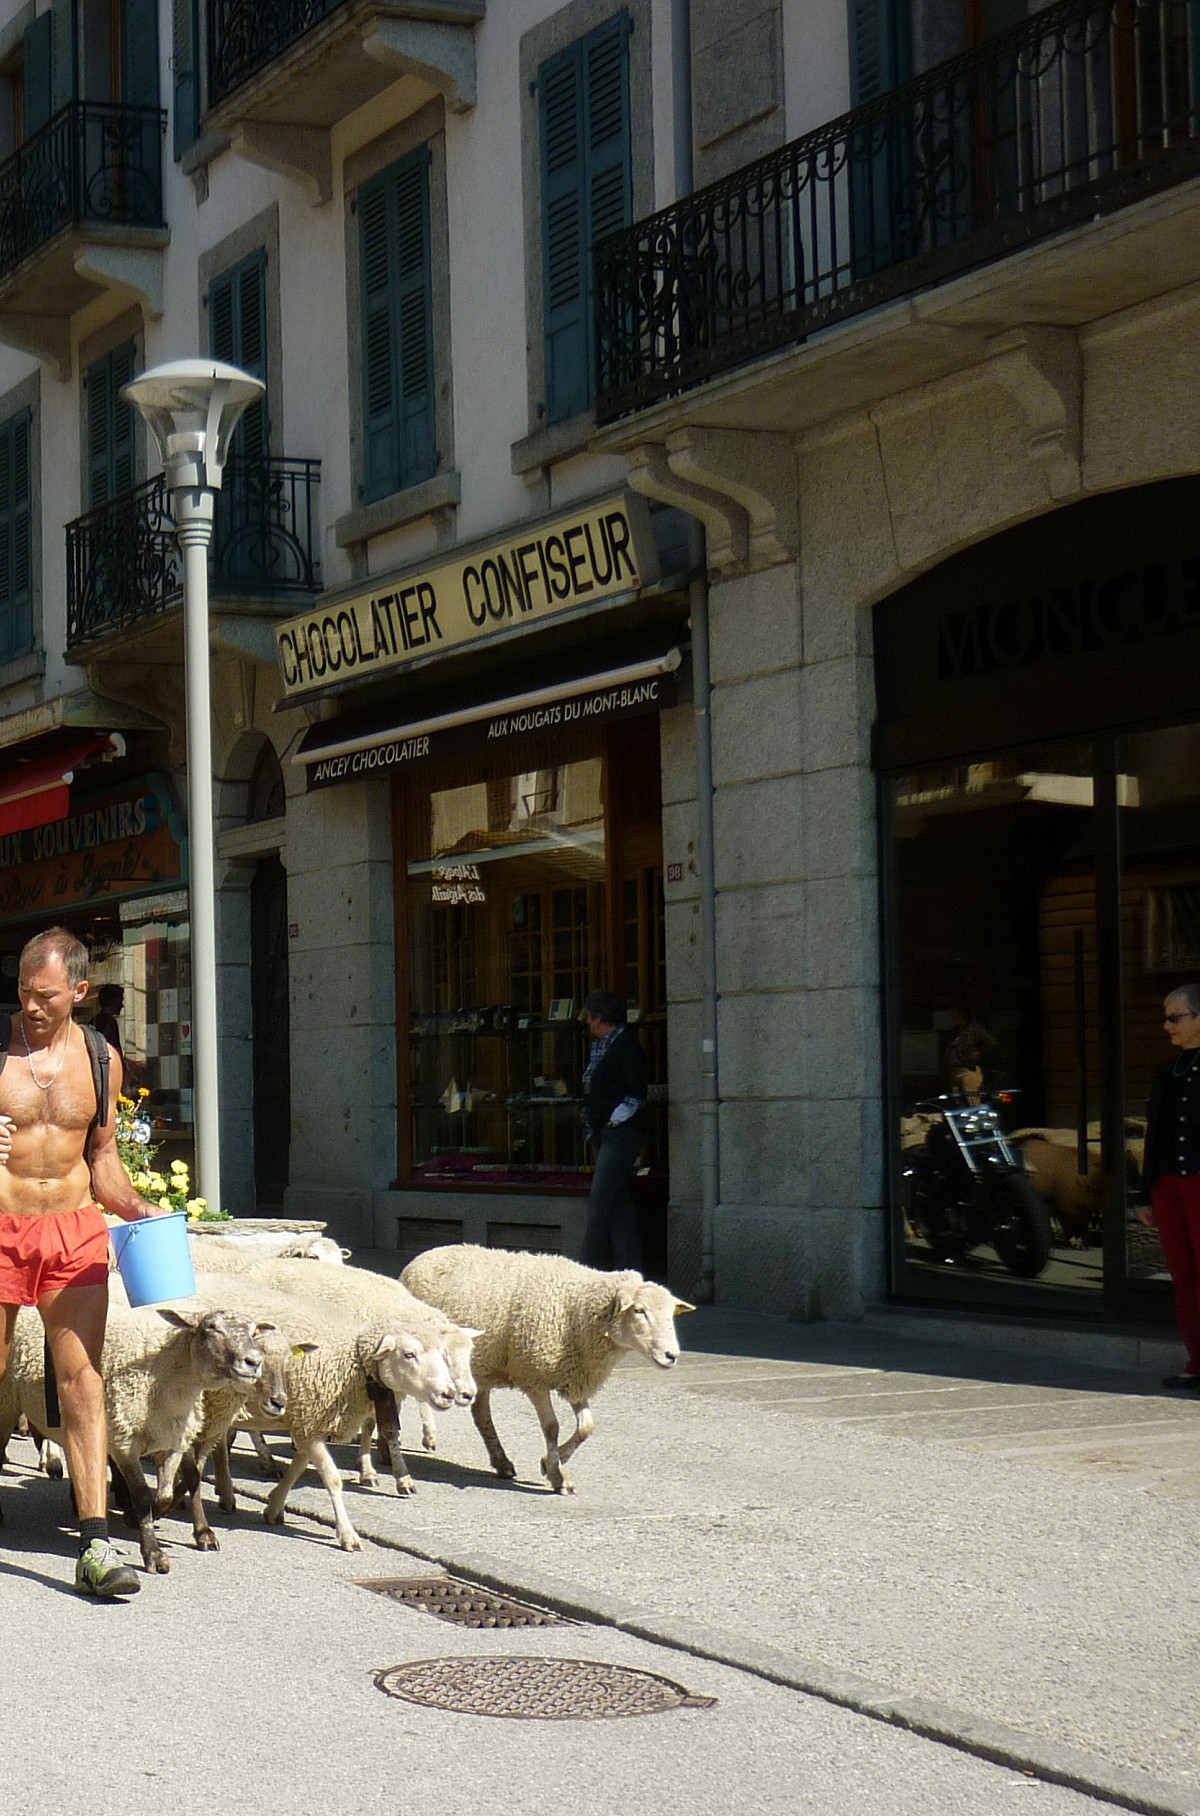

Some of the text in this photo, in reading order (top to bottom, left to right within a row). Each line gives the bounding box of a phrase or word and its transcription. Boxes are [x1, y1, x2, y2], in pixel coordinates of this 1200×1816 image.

[278, 511, 637, 686] CHOCOLATIER CONFISEUR
[487, 681, 659, 740] AUX NOUGATS DU MONT-BLANC
[313, 736, 430, 782] ANCEY CHOCOLATIER
[32, 796, 147, 862] SOUVENIRS
[668, 865, 681, 880] 98
